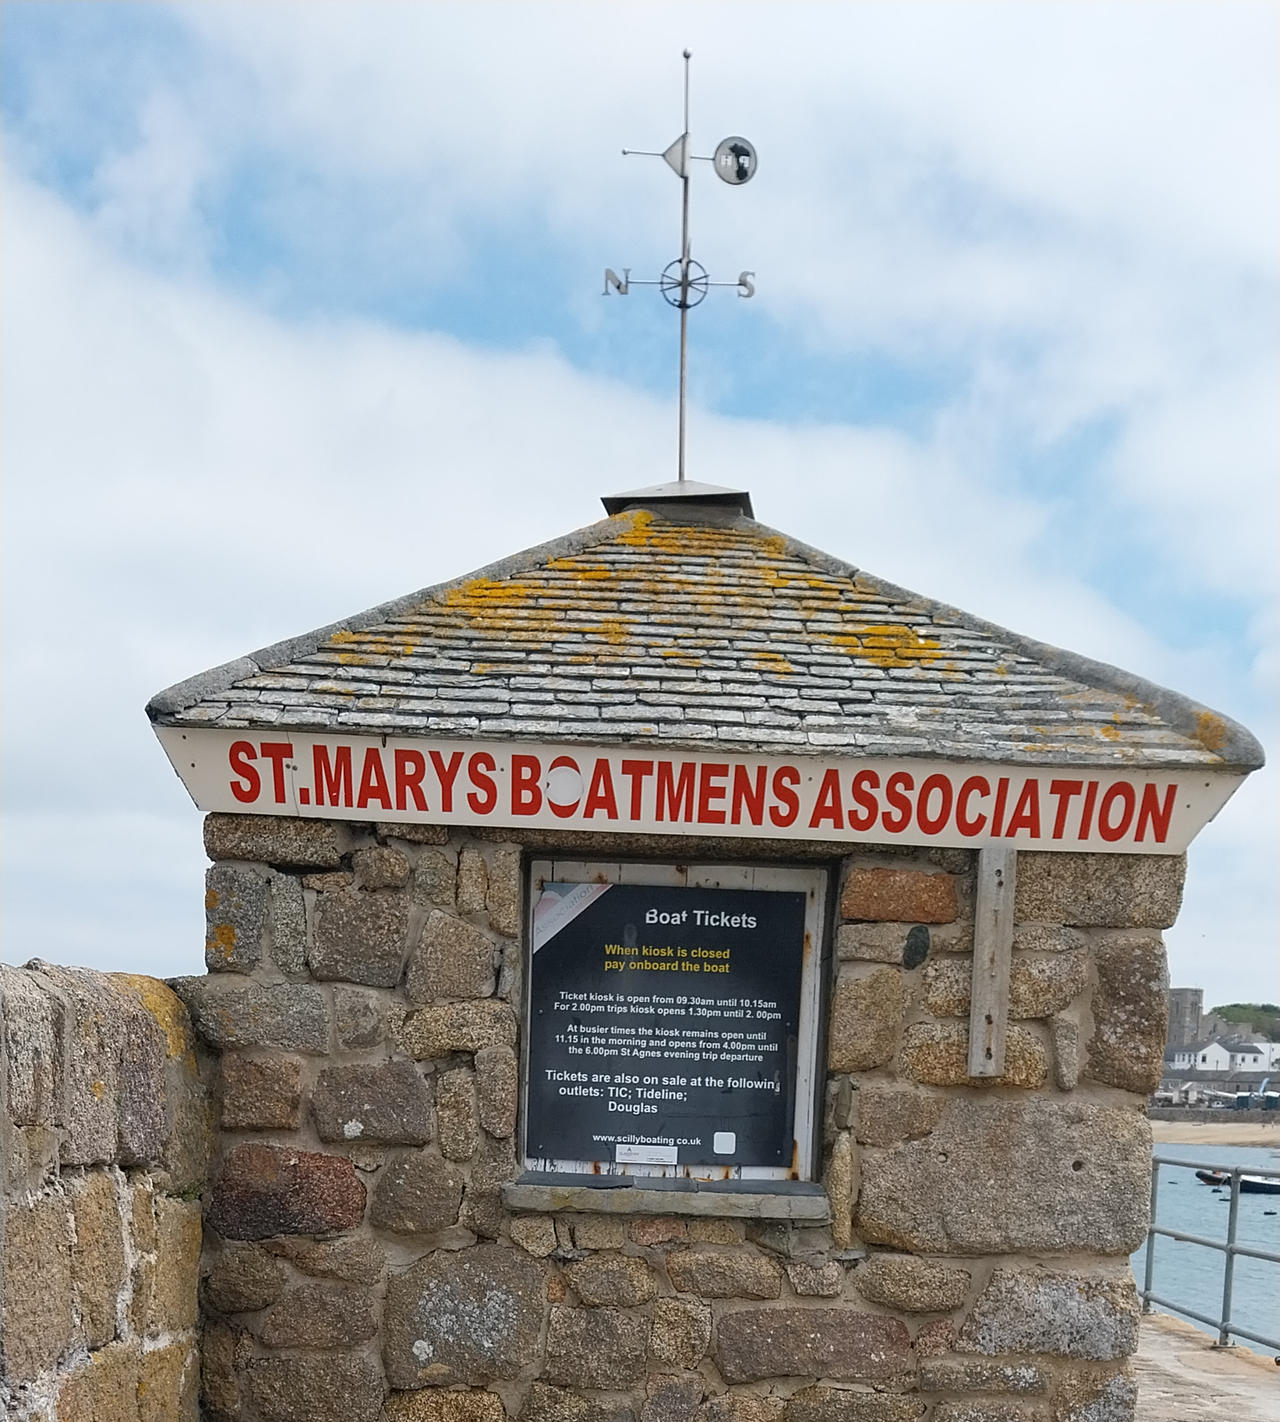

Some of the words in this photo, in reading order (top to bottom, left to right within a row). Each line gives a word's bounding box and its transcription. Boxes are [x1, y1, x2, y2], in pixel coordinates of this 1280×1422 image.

[602, 267, 631, 296] N
[737, 270, 756, 298] S
[808, 768, 1179, 844] ASSOCIATION
[645, 908, 688, 926] Boat
[692, 910, 758, 929] Tickets
[604, 944, 639, 956] When
[642, 945, 674, 957] kiosk
[677, 946, 688, 958] is
[690, 947, 731, 960] closed
[604, 961, 626, 972] pay
[628, 960, 679, 972] onboard
[681, 961, 701, 973] the
[703, 962, 731, 974] boat
[559, 991, 588, 1001] Ticket
[589, 992, 614, 1002] kiosk
[616, 993, 625, 1002] is
[627, 994, 651, 1005] open
[652, 995, 675, 1005] from
[676, 996, 715, 1007] 09.30am
[716, 998, 738, 1008] until
[740, 999, 778, 1010] 10.15am
[554, 1002, 571, 1011] For
[607, 1004, 629, 1015] trips
[630, 1005, 656, 1015] kiosk
[657, 1007, 687, 1017] opens
[688, 1007, 722, 1019] 1.30pm
[723, 1010, 745, 1019] until
[567, 1024, 579, 1034] At
[580, 1025, 609, 1035] busier
[610, 1026, 637, 1036] times
[638, 1027, 654, 1037] the
[655, 1028, 681, 1038] kiosk
[682, 1029, 719, 1039] remains
[721, 1032, 745, 1042] open
[746, 1032, 768, 1042] until
[555, 1035, 580, 1045] 11.15
[580, 1035, 591, 1045] in
[591, 1036, 608, 1046] the
[608, 1038, 648, 1049] morning
[648, 1039, 668, 1048] and
[668, 1041, 698, 1051] opens
[699, 1041, 722, 1050] from
[722, 1042, 757, 1053] 4.00pm
[757, 1044, 779, 1053] until
[568, 1046, 585, 1056] the
[585, 1047, 620, 1058] 6.00pm
[620, 1048, 632, 1058] St
[632, 1049, 663, 1060] Agnes
[664, 1051, 702, 1062] evening
[702, 1052, 719, 1063] trip
[720, 1053, 765, 1063] departure
[545, 1070, 590, 1083] Tickets
[591, 1074, 612, 1084] are
[614, 1073, 641, 1085] also
[643, 1076, 660, 1086] on
[662, 1075, 688, 1087] sale
[690, 1077, 703, 1088] at
[705, 1077, 725, 1089] the
[559, 1086, 605, 1098] outlets:
[608, 1087, 633, 1101] TIC;
[636, 1088, 689, 1103] Tideline;
[608, 1101, 659, 1116] Douglas
